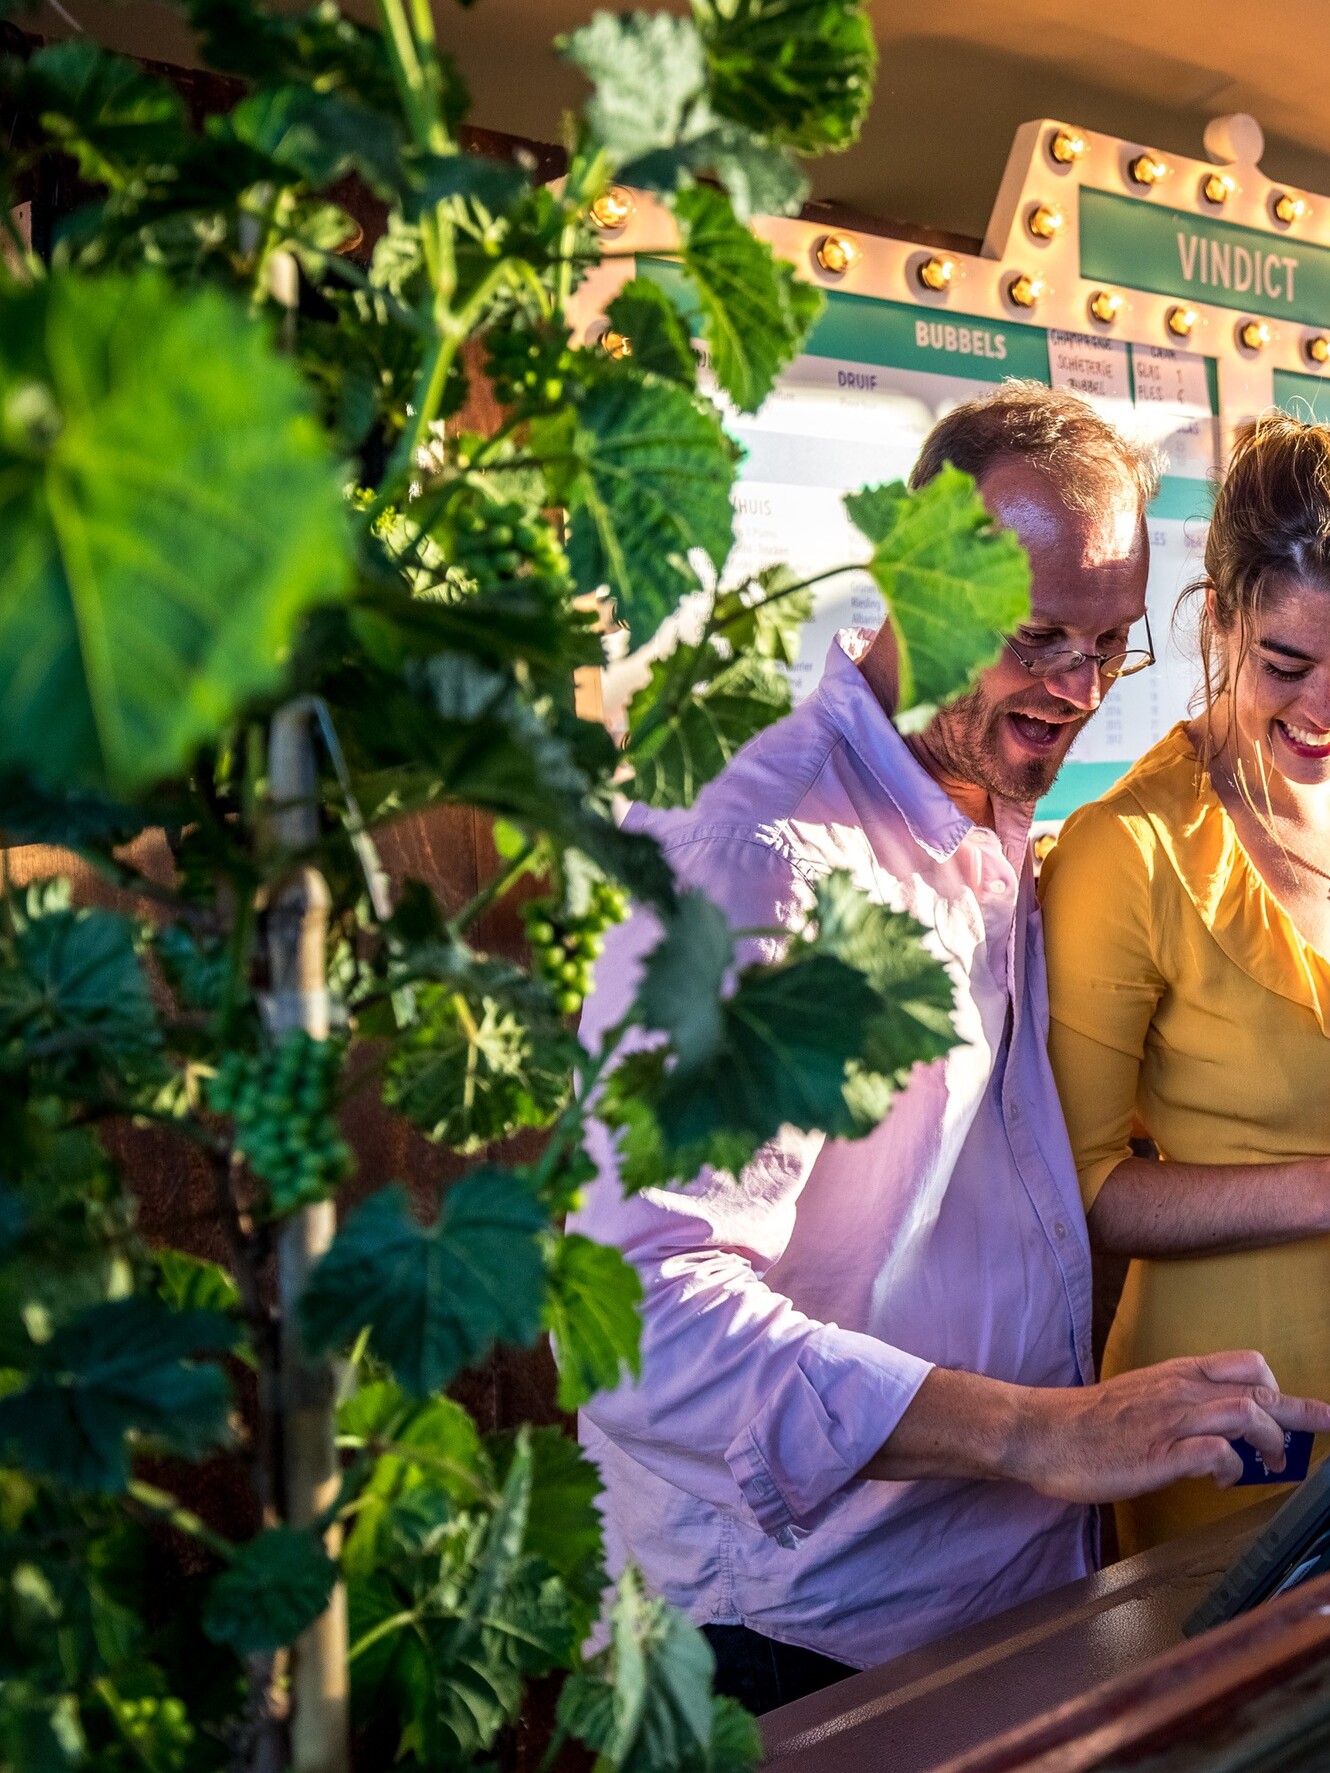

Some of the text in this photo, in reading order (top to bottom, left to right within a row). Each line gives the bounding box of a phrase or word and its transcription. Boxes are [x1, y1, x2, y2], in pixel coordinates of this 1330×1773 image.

[1176, 232, 1299, 302] VINDICT
[914, 319, 1007, 360] BUBBELS
[837, 369, 878, 392] DRUIF
